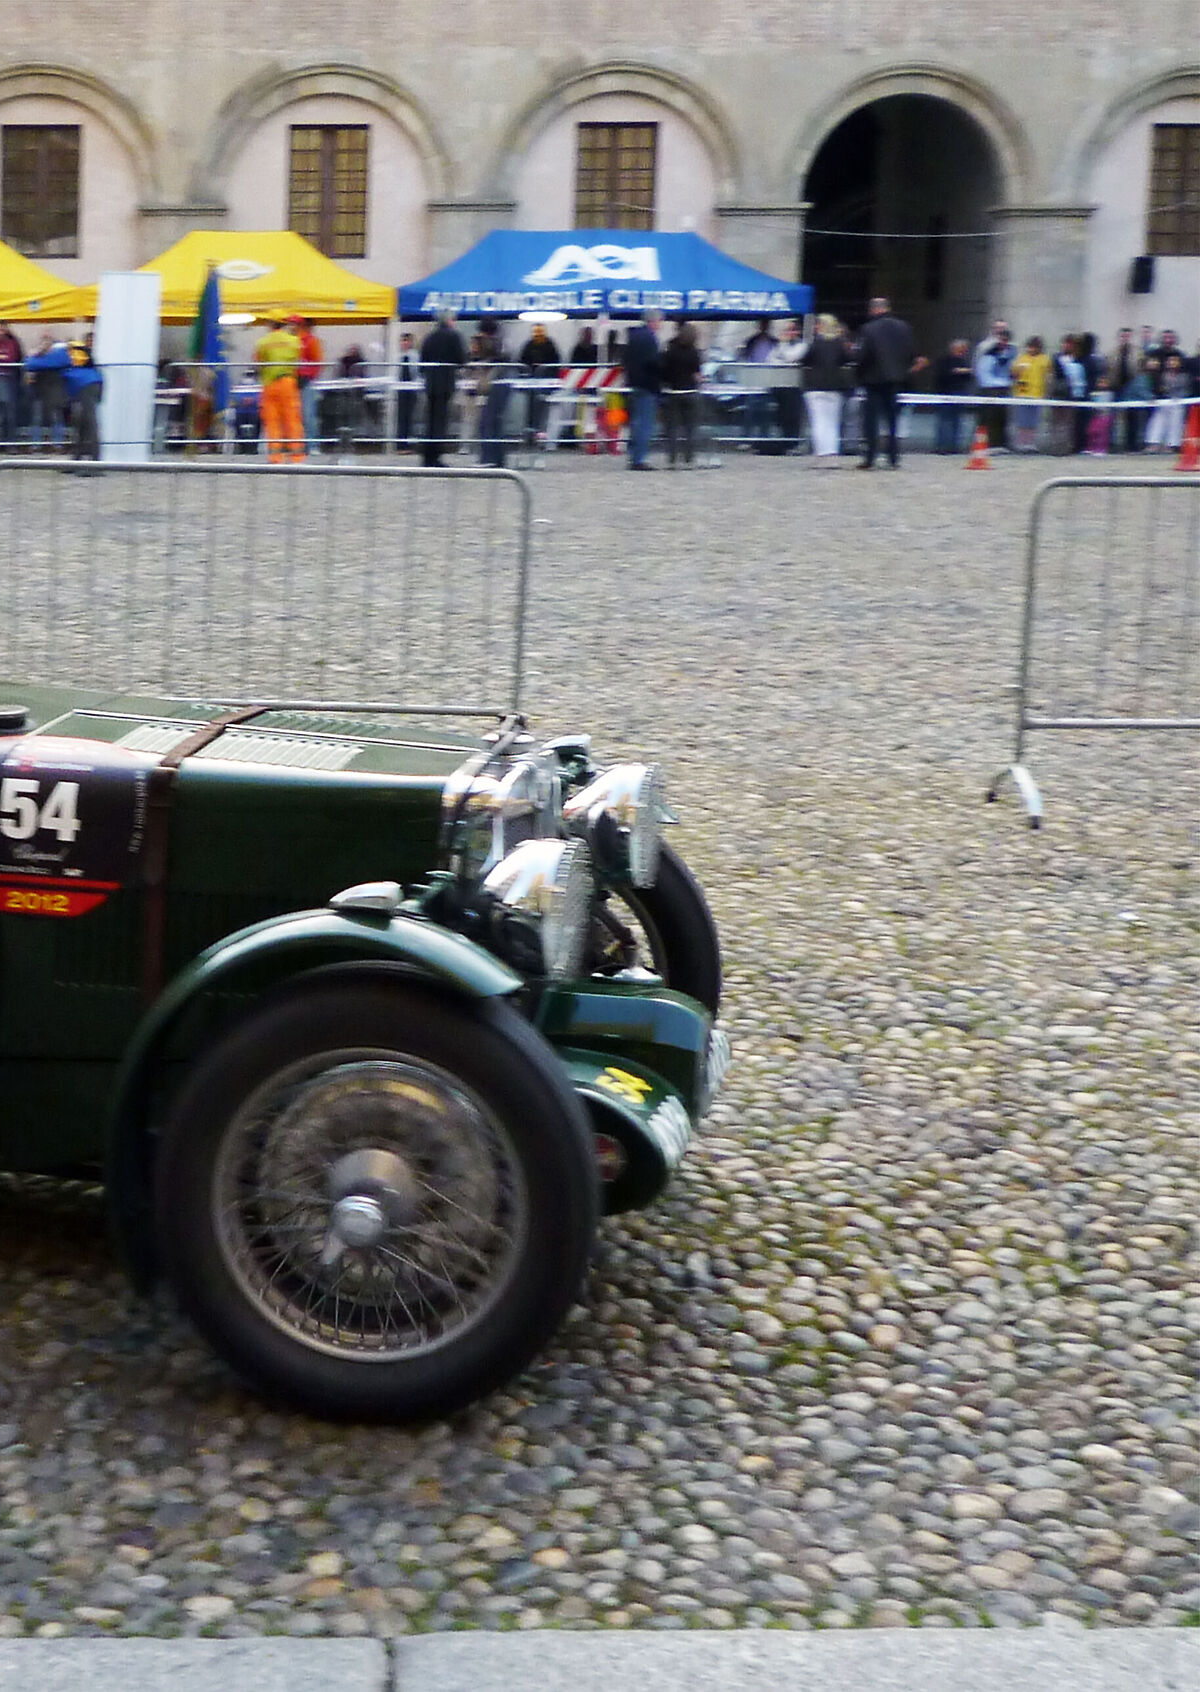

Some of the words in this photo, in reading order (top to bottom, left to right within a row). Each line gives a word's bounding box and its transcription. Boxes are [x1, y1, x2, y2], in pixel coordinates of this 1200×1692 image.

[521, 244, 662, 286] ACI
[420, 289, 604, 311] AUTOMOBILE
[608, 289, 684, 310] CLUB
[687, 290, 791, 312] PARMA
[5, 891, 70, 912] 2012
